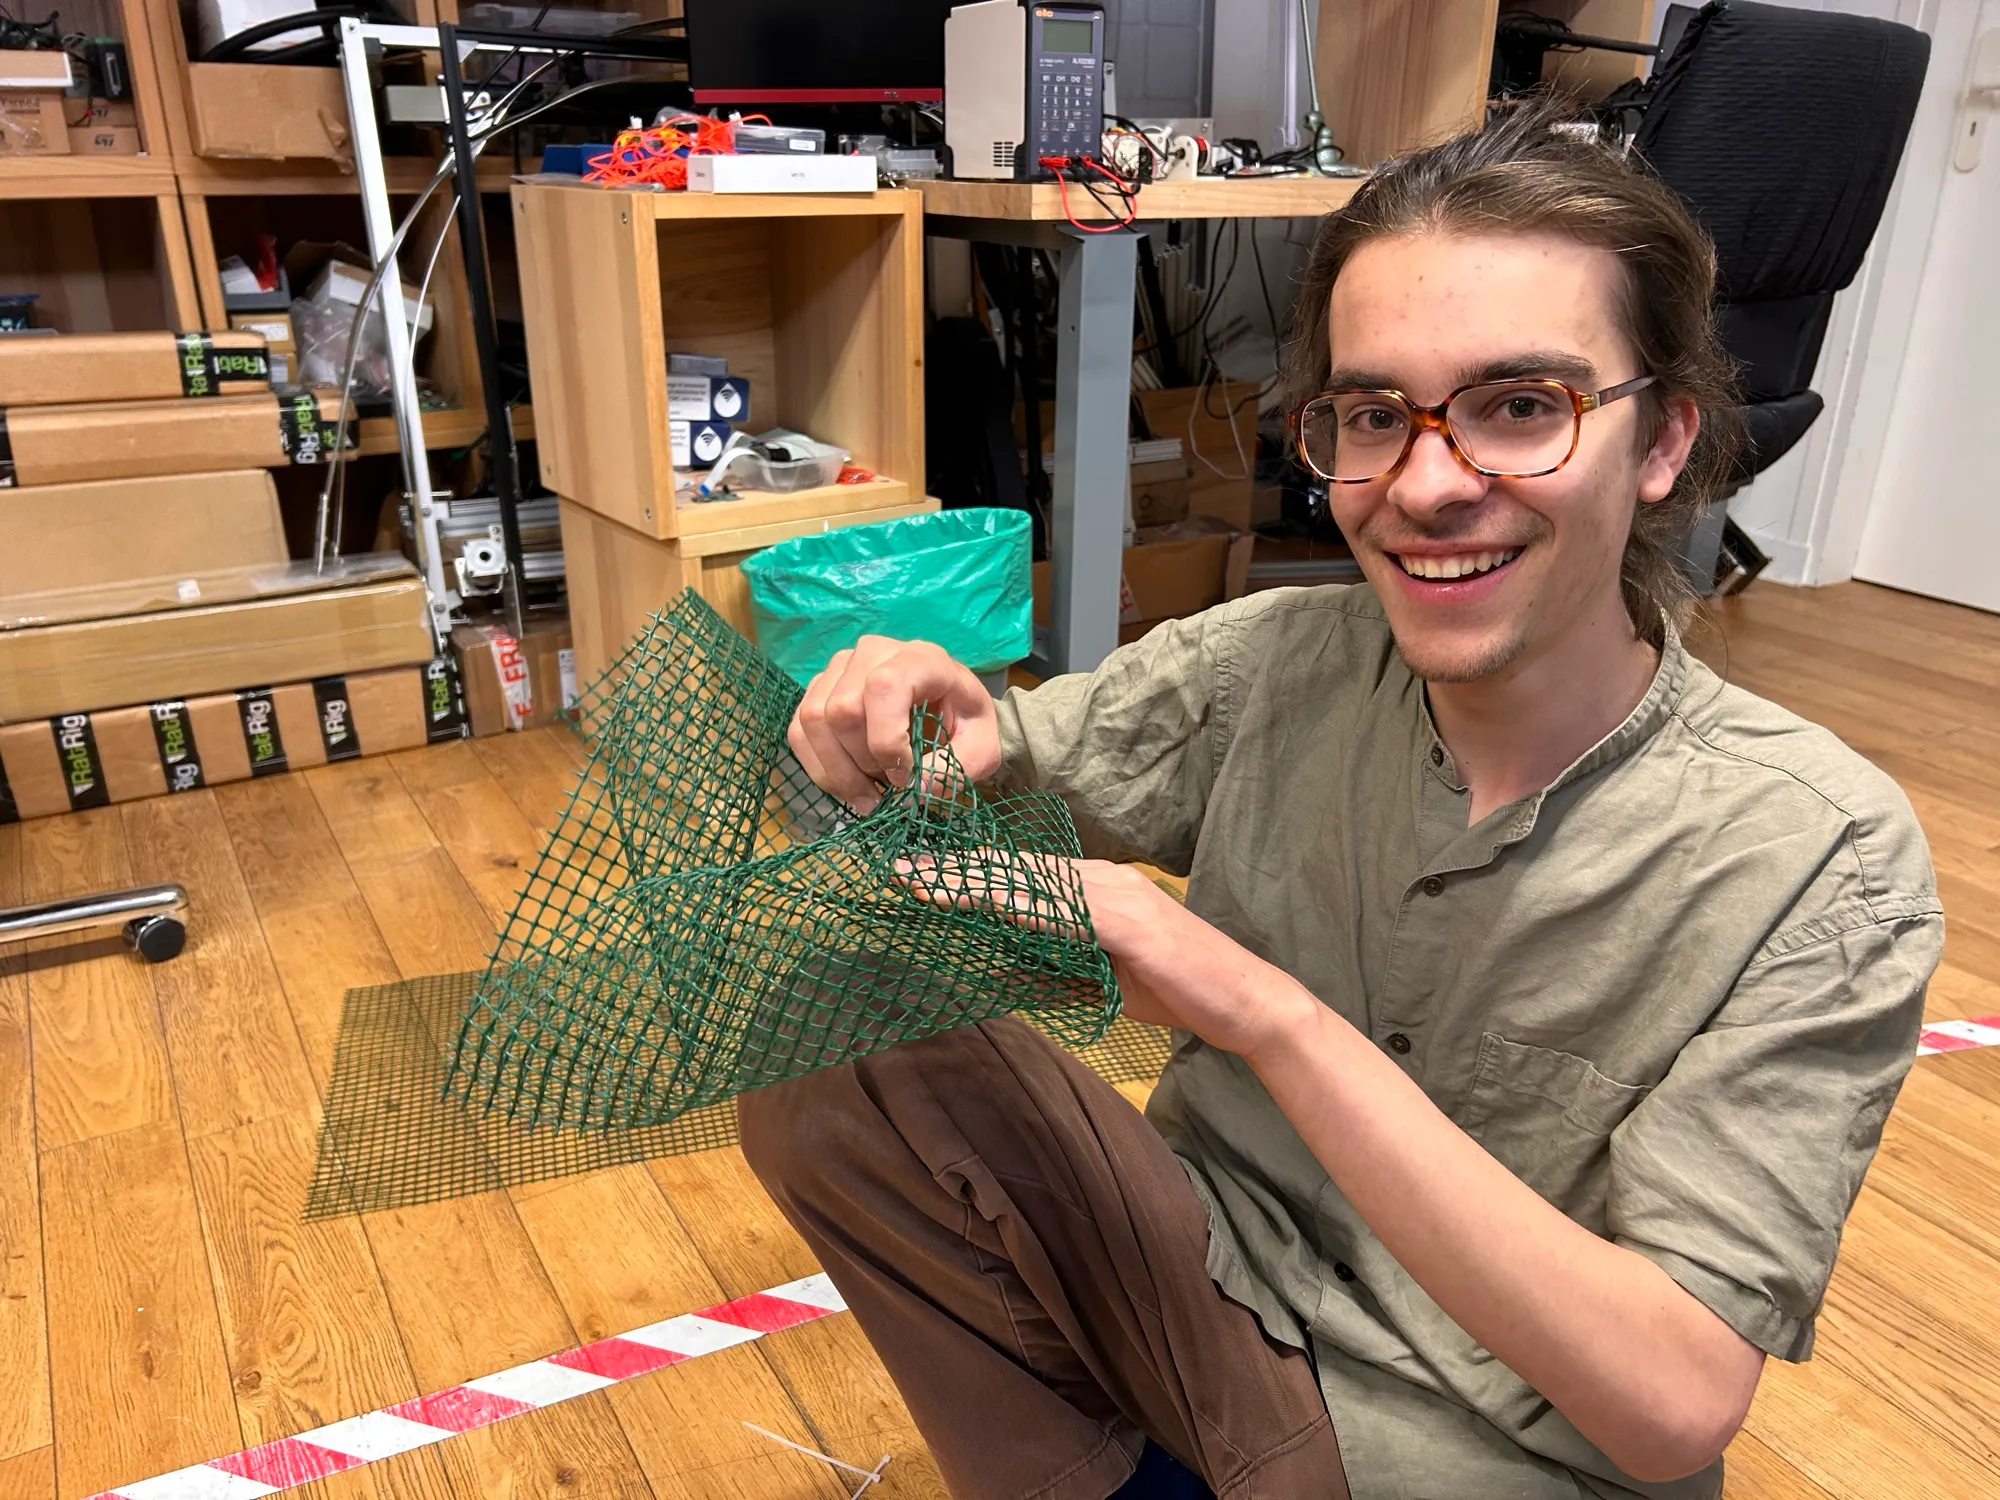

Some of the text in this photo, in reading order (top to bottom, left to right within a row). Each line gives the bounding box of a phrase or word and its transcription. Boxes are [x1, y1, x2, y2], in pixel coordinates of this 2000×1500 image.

[293, 398, 320, 464] RatRig
[428, 659, 450, 711] RatR
[59, 714, 94, 785] RatRig
